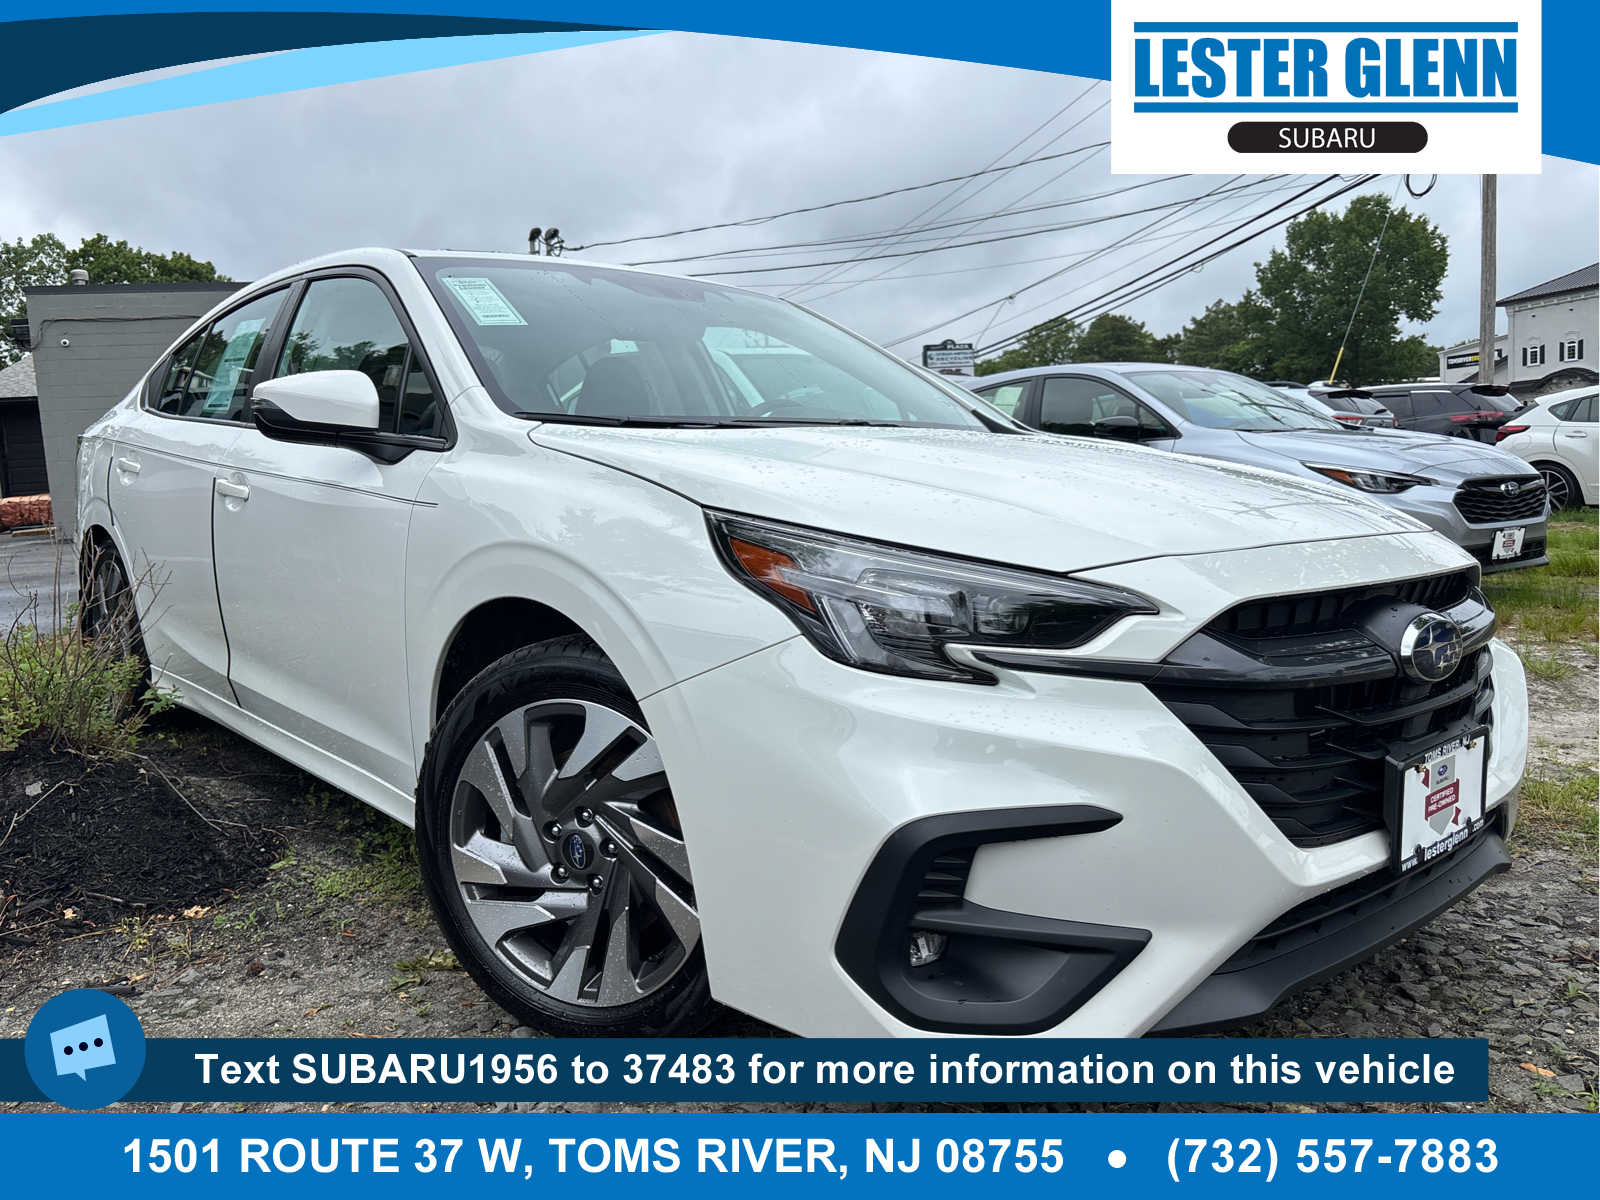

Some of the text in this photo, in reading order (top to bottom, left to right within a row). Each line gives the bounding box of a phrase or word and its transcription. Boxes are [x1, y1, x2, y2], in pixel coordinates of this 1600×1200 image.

[1425, 747, 1442, 762] TOMS
[1462, 735, 1471, 746] NJ
[1428, 795, 1456, 811] PRE-OWNED
[1430, 787, 1454, 803] CERTIFIED
[1424, 828, 1469, 861] lesterglenn
